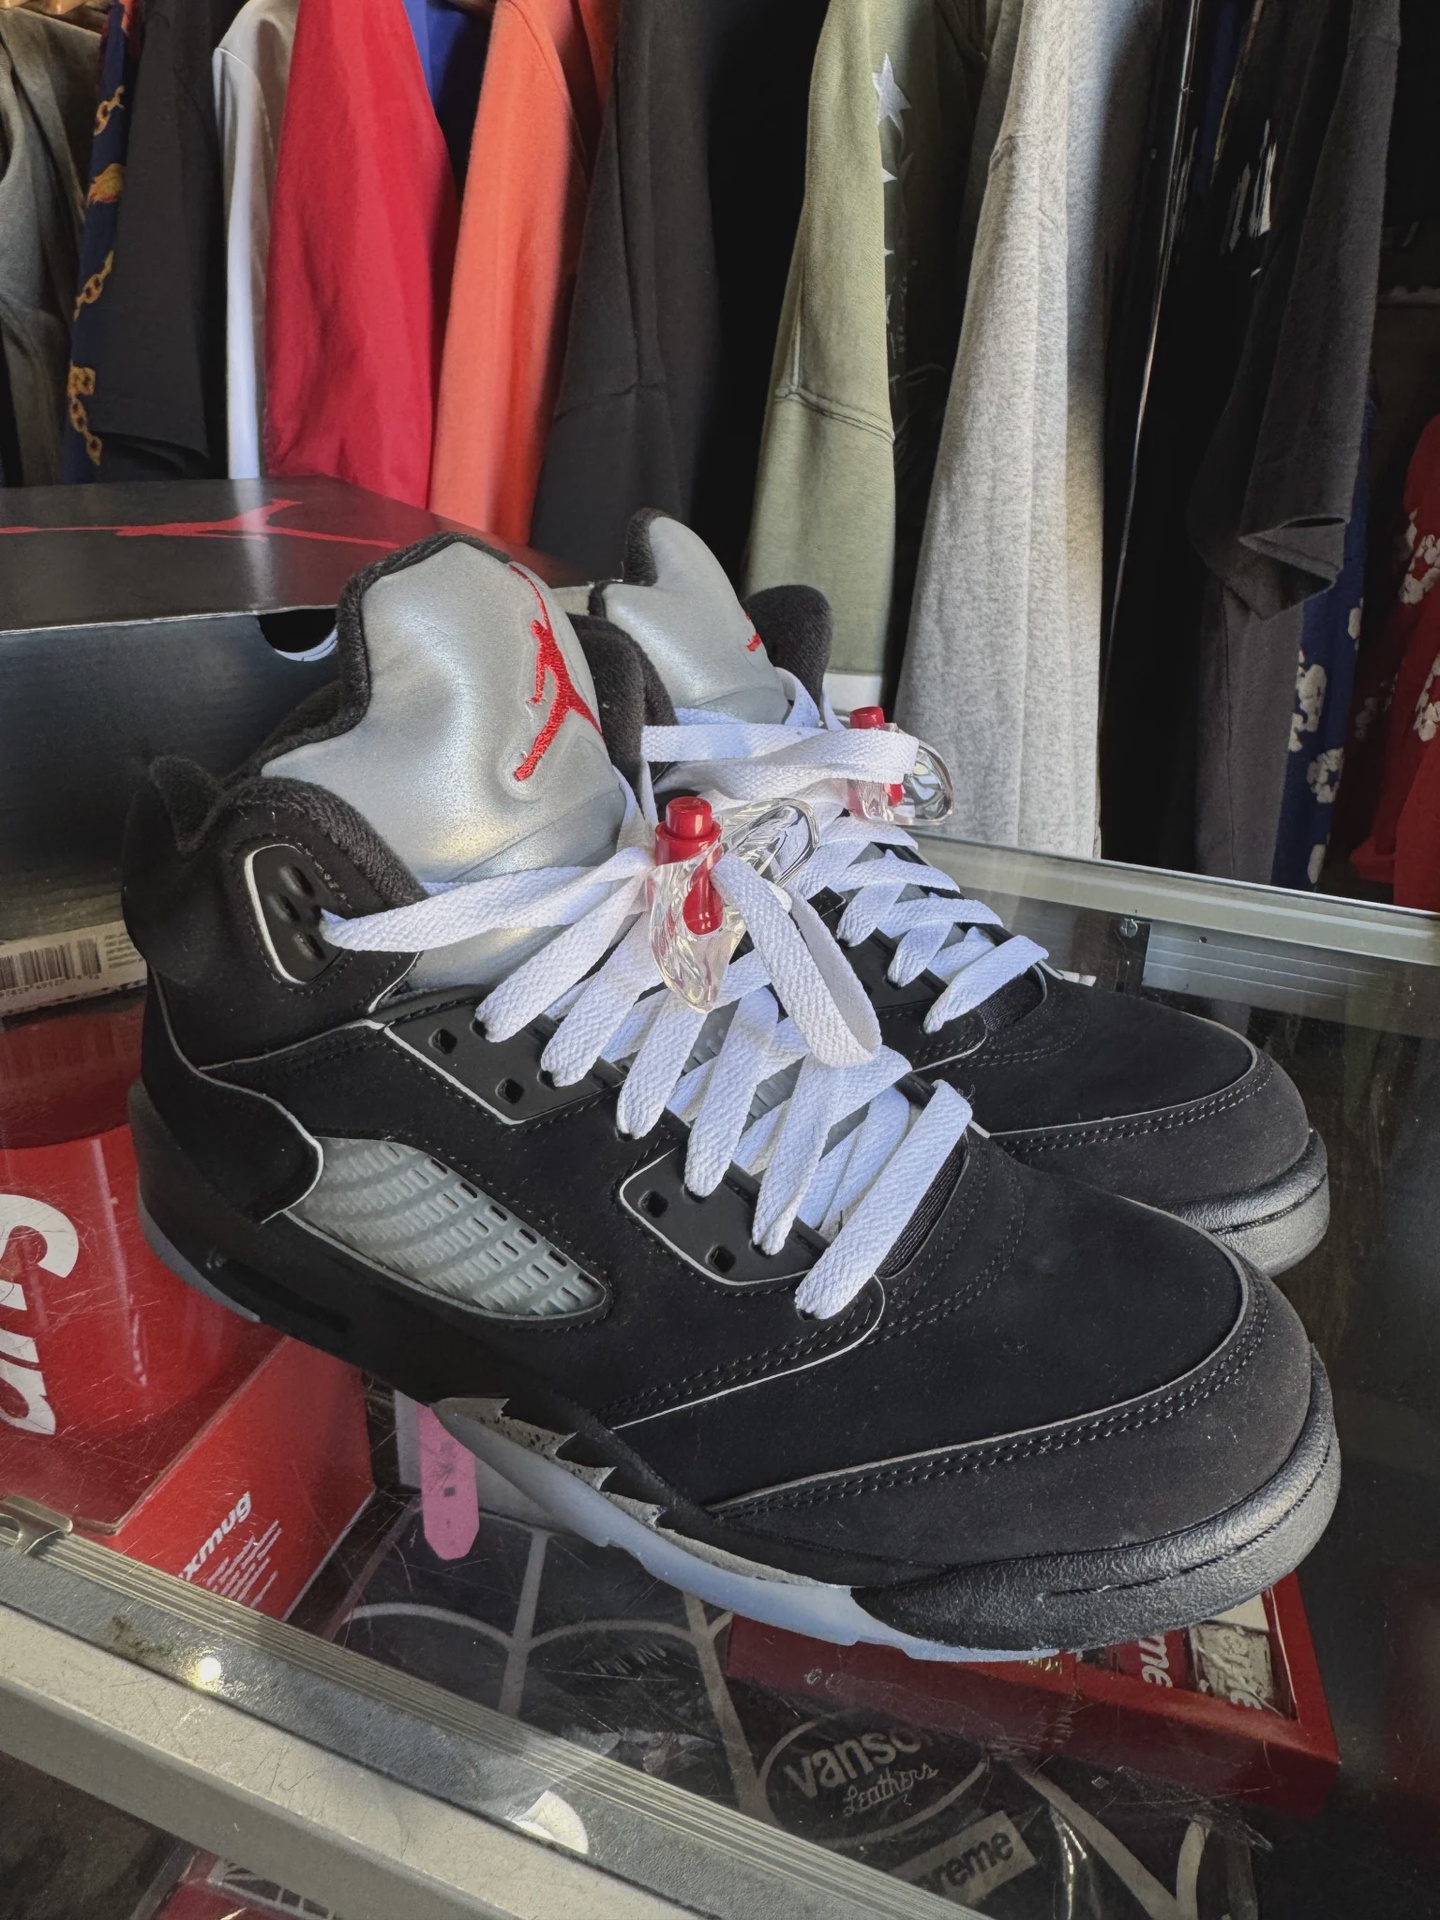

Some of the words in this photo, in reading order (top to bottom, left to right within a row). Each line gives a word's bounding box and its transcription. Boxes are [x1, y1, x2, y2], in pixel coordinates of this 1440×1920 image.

[178, 1490, 252, 1581] xmug
[1138, 1634, 1173, 1688] me
[842, 1763, 939, 1818] Leathers
